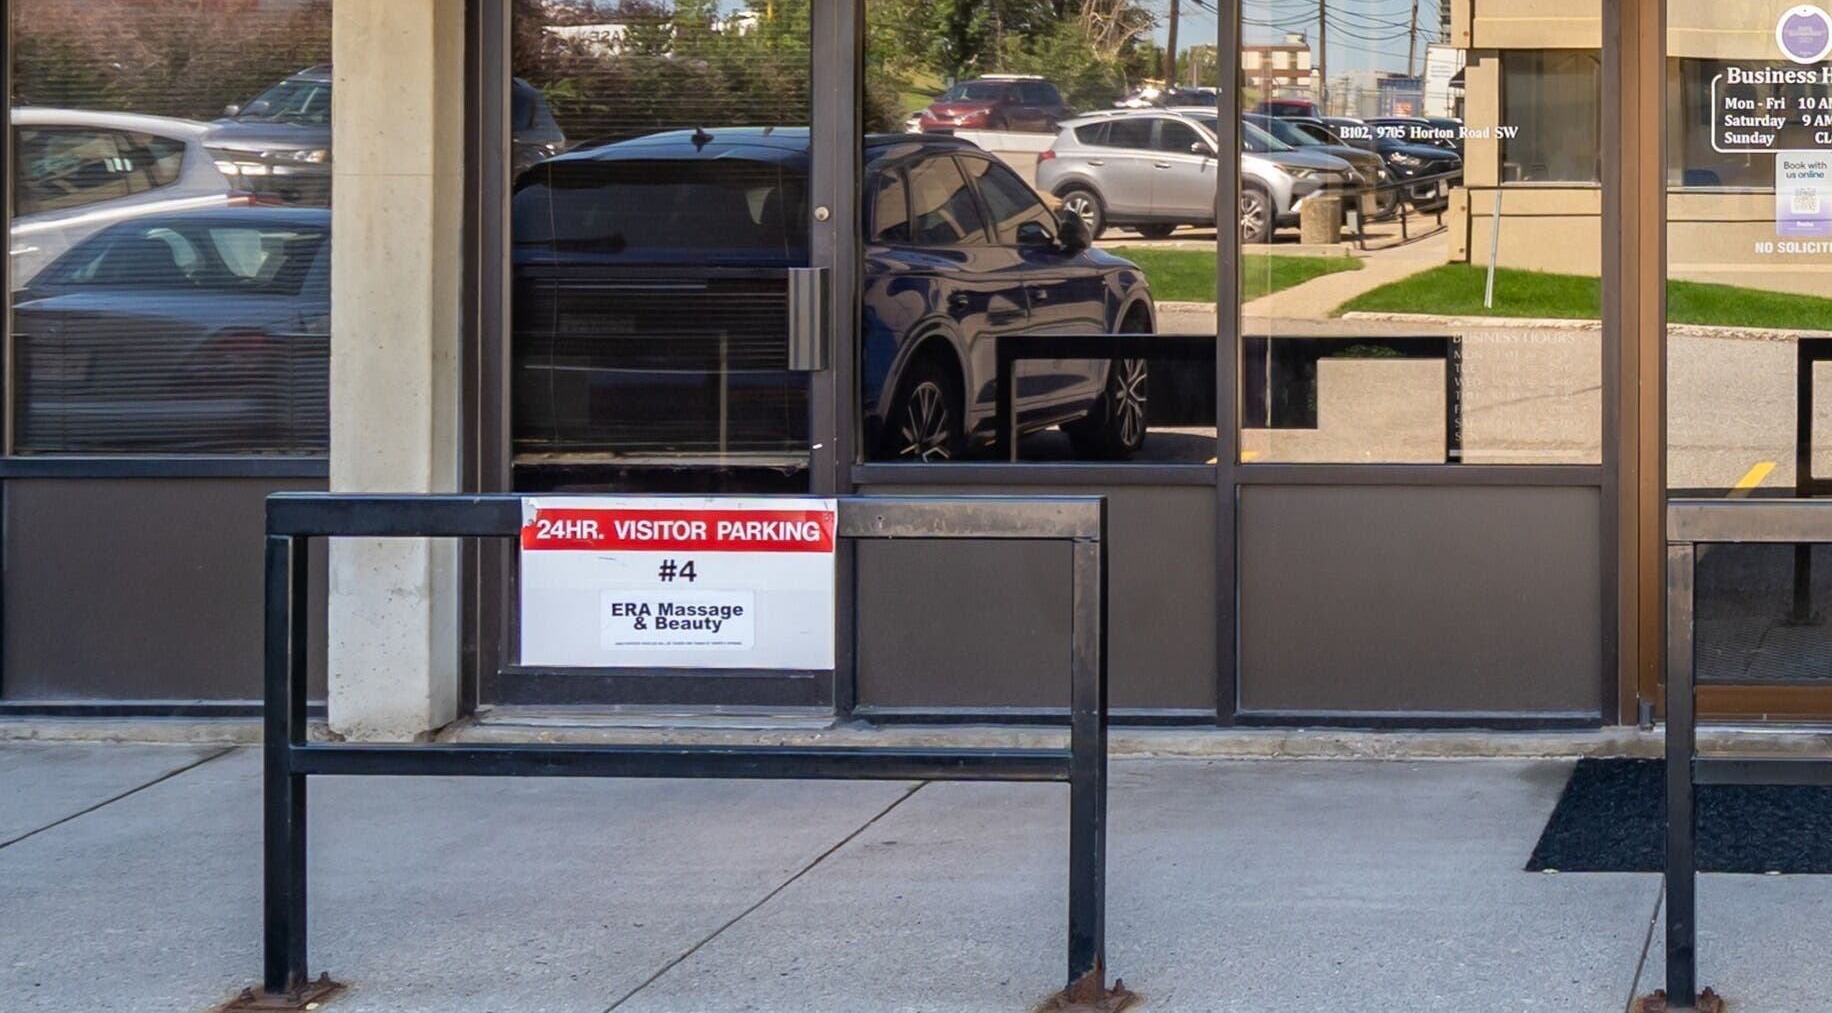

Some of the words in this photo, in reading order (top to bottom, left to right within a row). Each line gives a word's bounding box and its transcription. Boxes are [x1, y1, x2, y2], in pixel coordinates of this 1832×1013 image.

[1727, 67, 1817, 84] Business
[1724, 97, 1755, 110] Mon
[1766, 97, 1786, 110] Fri
[1798, 97, 1815, 109] 10
[1724, 114, 1786, 129] Saturday
[1801, 114, 1811, 127] 9
[1340, 127, 1373, 141] B102,
[1377, 125, 1406, 139] 9705
[1410, 126, 1454, 139] Horton
[1458, 126, 1490, 139] Road
[1494, 126, 1519, 139] SW
[1724, 131, 1775, 147] Sunday
[1783, 161, 1806, 170] Book
[1807, 161, 1828, 170] with
[1786, 171, 1797, 179] us
[1798, 170, 1825, 179] online
[1755, 242, 1773, 254] NO
[536, 519, 604, 539] 24HR.
[614, 520, 707, 540] VISITOR
[717, 521, 821, 542] PARKING
[658, 559, 697, 582] #4
[611, 603, 651, 617] ERA
[658, 603, 744, 620] Massage
[633, 616, 648, 630] &
[655, 616, 723, 633] Beauty
